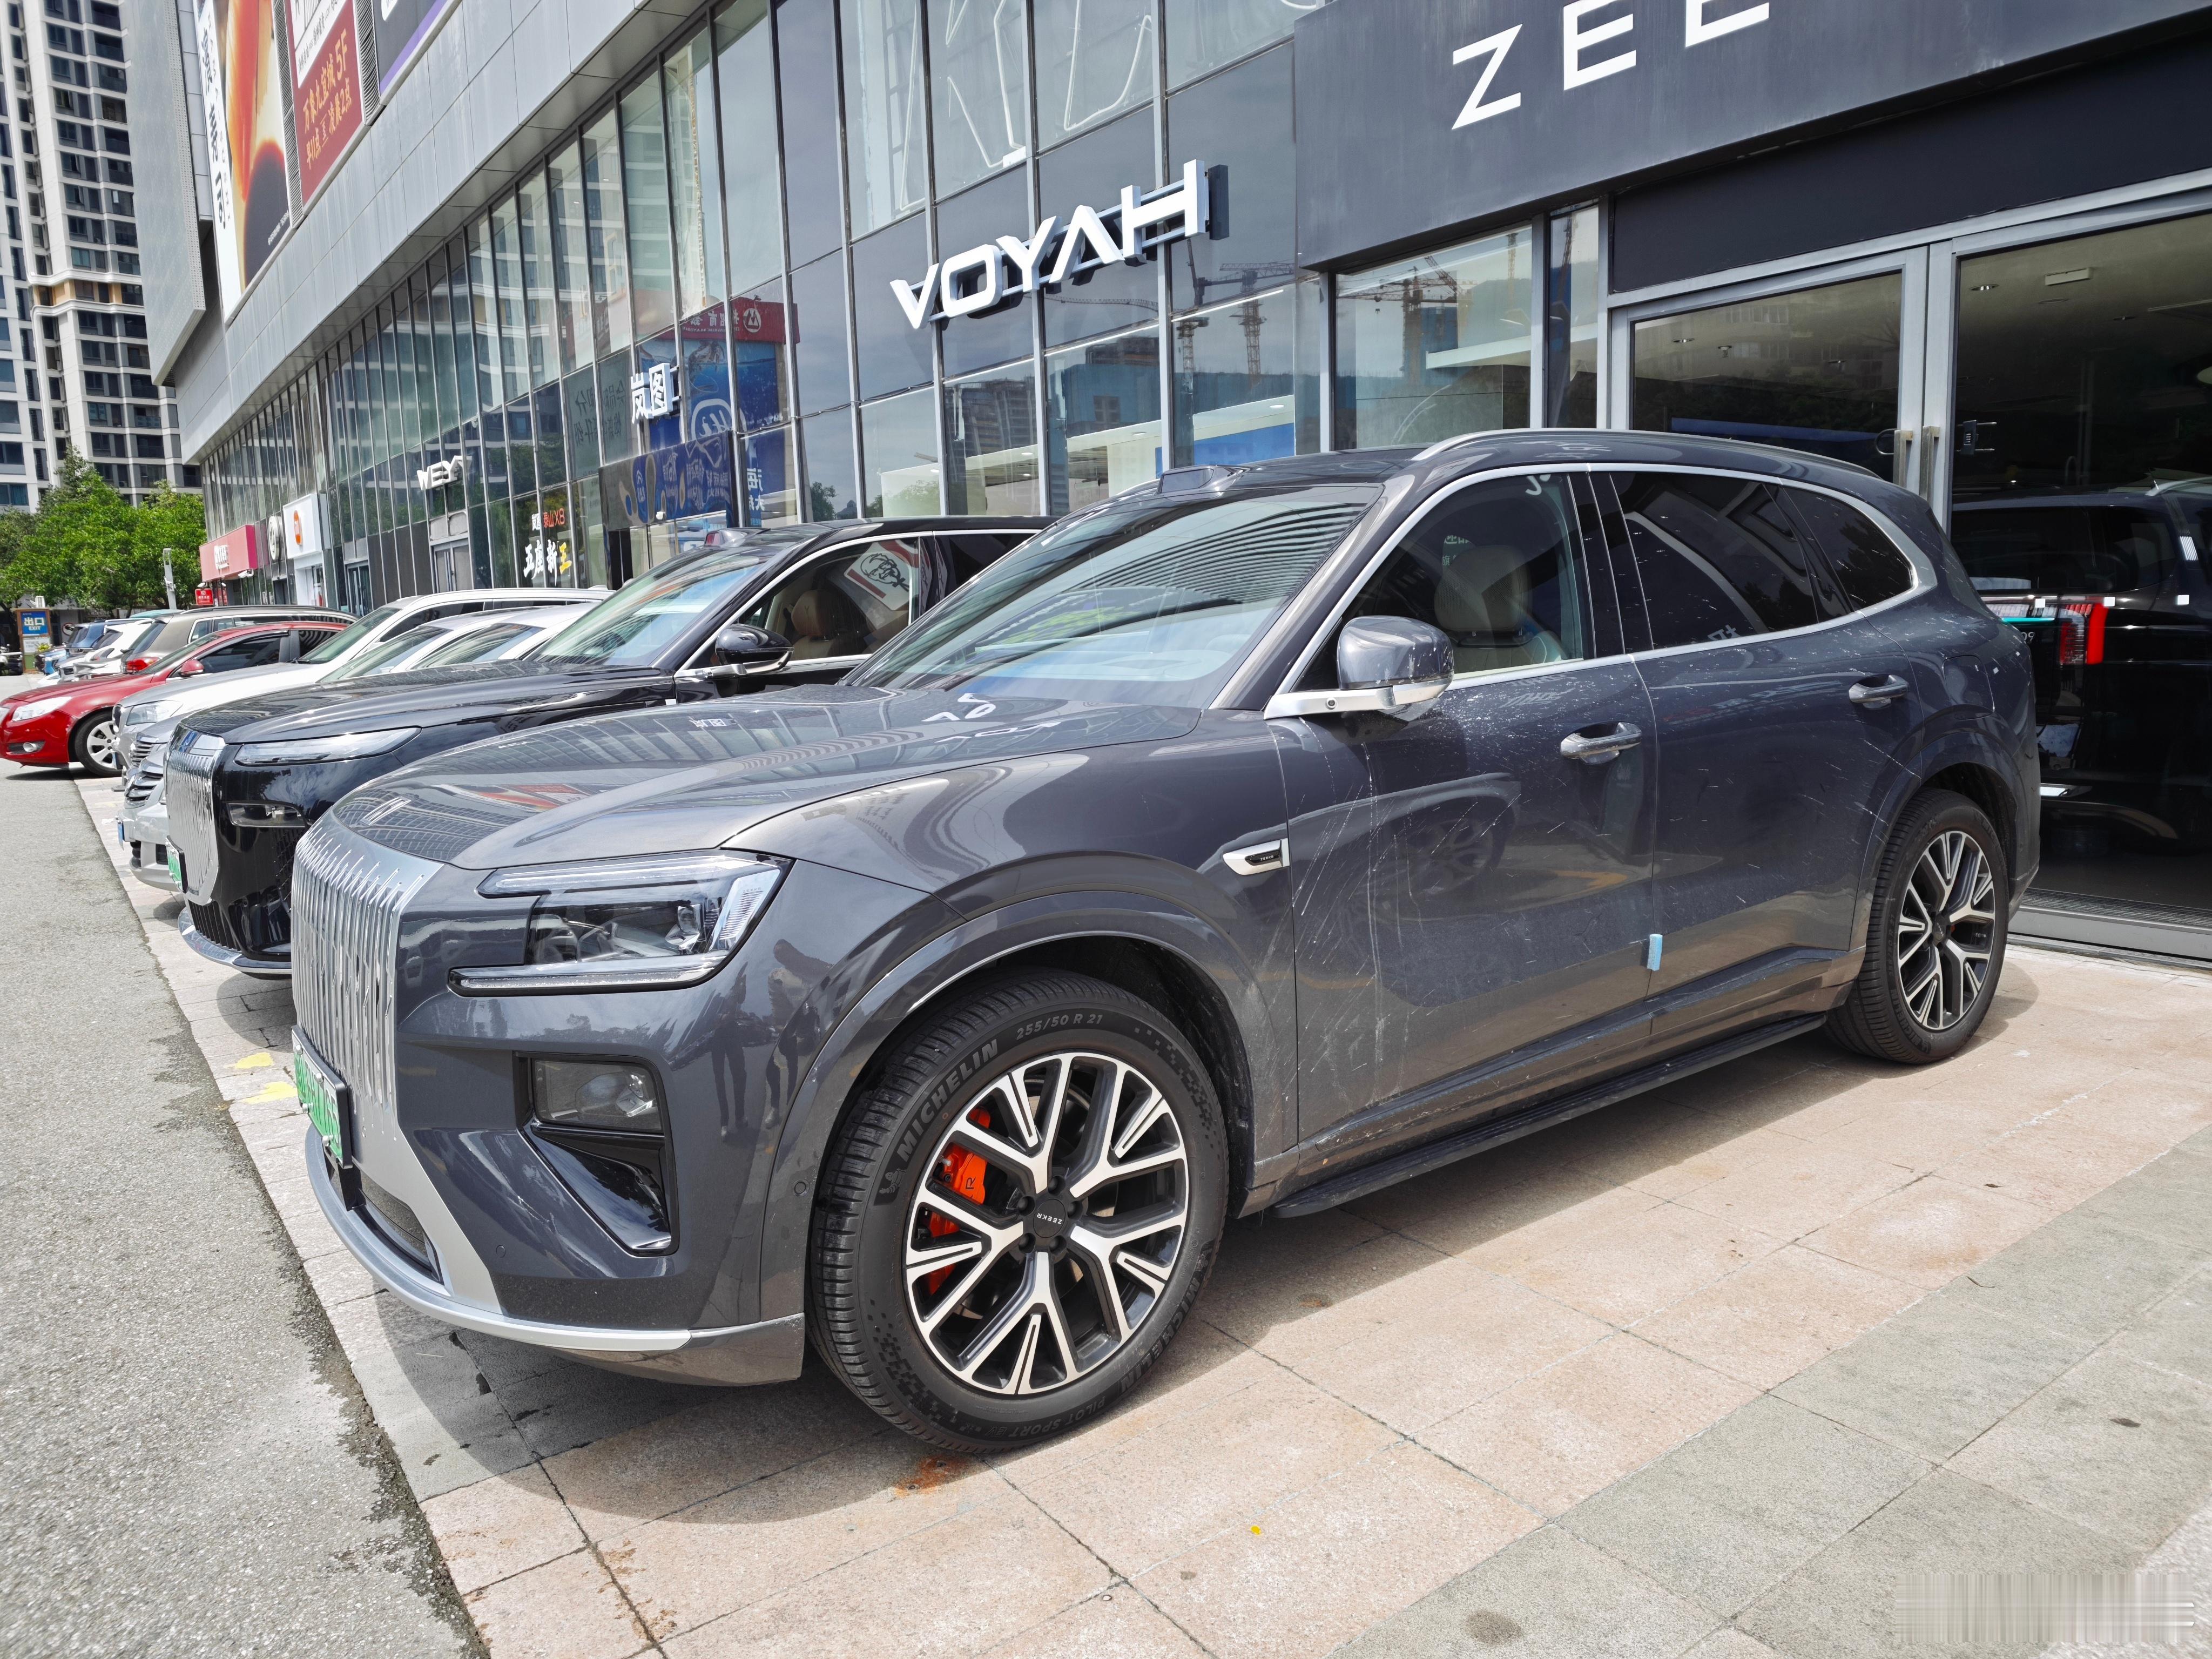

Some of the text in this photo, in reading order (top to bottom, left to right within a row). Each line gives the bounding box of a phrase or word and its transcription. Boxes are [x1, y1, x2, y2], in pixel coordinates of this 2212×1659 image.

[335, 28, 348, 81] 5F
[890, 159, 1206, 329] VOYAH
[630, 362, 672, 424] 岚图
[416, 455, 472, 490] WEY
[523, 539, 572, 587] 五座新王
[24, 617, 44, 626] 出口
[896, 1014, 1103, 1162] MICHELIN 255/50 R 21
[1036, 1212, 1063, 1225] ZEEKR
[1121, 1277, 1201, 1393] MICHELIN
[1008, 1419, 1063, 1438] SPORT
[1065, 1395, 1106, 1426] PILOT
